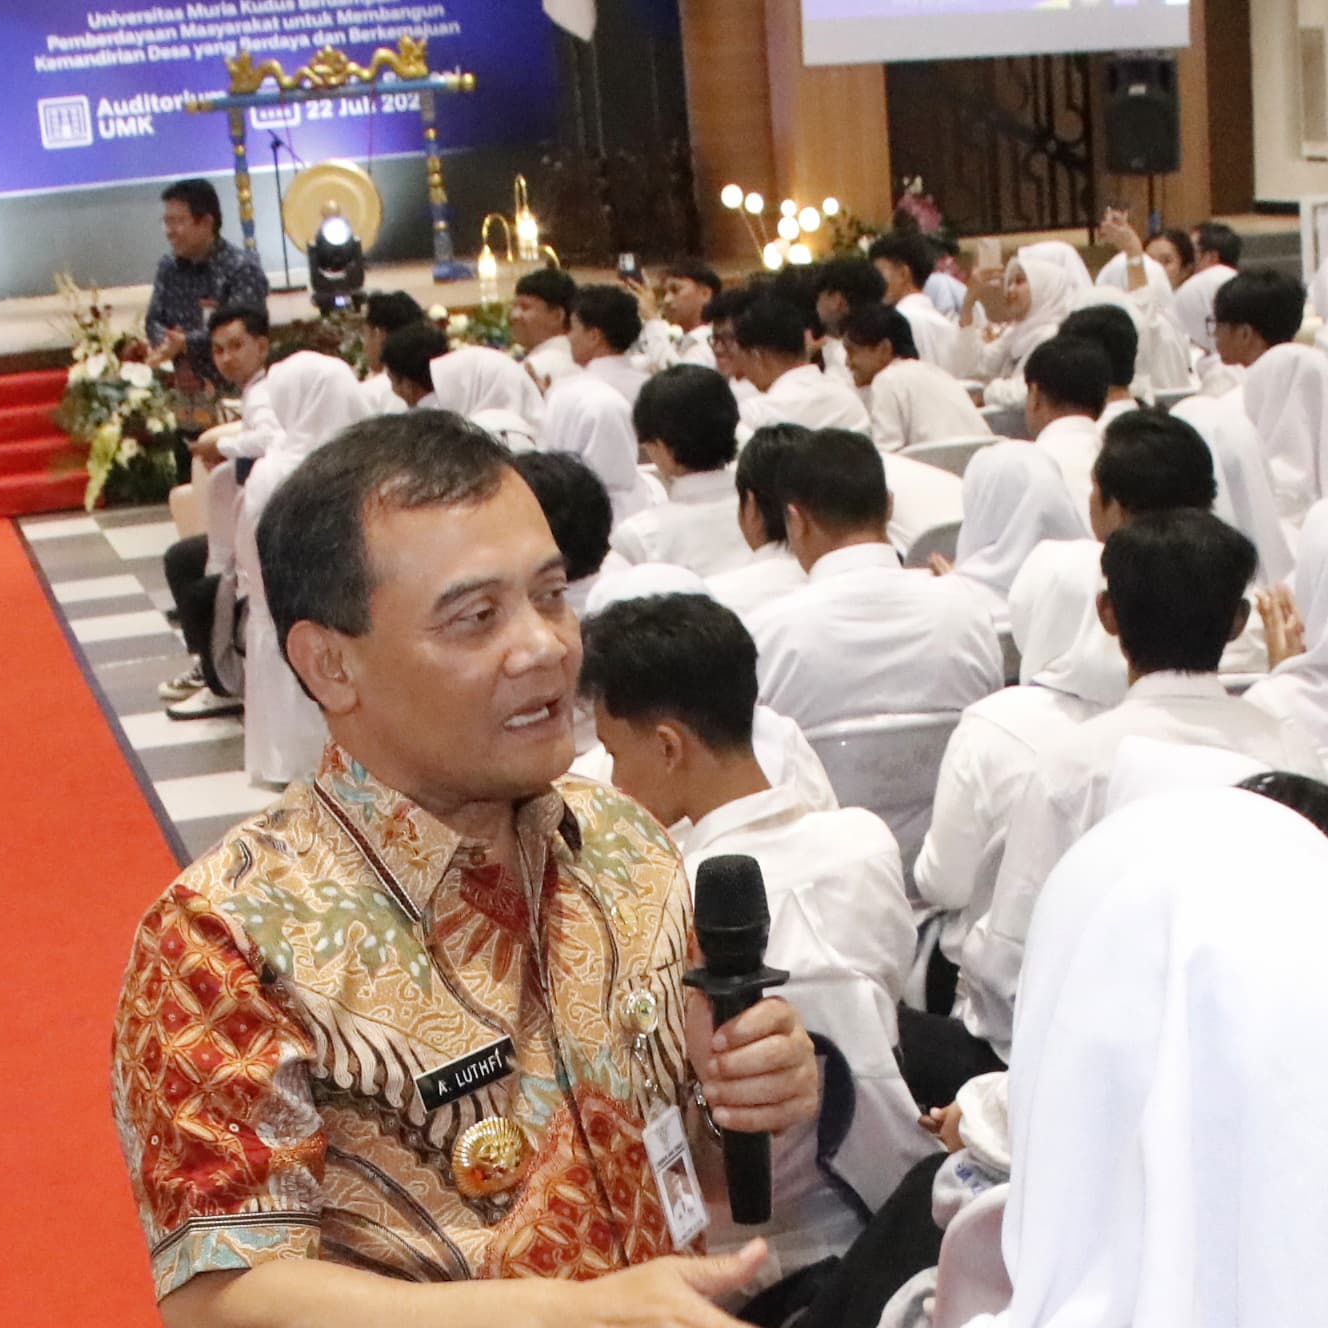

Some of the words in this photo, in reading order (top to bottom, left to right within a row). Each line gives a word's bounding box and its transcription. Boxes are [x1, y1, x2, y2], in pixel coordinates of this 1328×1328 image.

[47, 26, 177, 51] Pemberdayaan
[180, 16, 279, 40] Masyarakat
[284, 10, 333, 30] untuk
[337, 4, 445, 24] Membangun
[87, 7, 184, 29] Universitas
[188, 1, 238, 20] Muria
[240, 0, 293, 14] Kudus
[35, 47, 146, 72] Kemandirian
[147, 43, 191, 61] Desa
[193, 40, 236, 60] yang
[240, 32, 310, 51] Berdaya
[313, 29, 346, 45] dan
[306, 99, 333, 120] 22
[381, 92, 422, 113] 202
[98, 115, 155, 139] UMK
[438, 1080, 451, 1096] A.
[455, 1047, 503, 1088] LUTHFI
